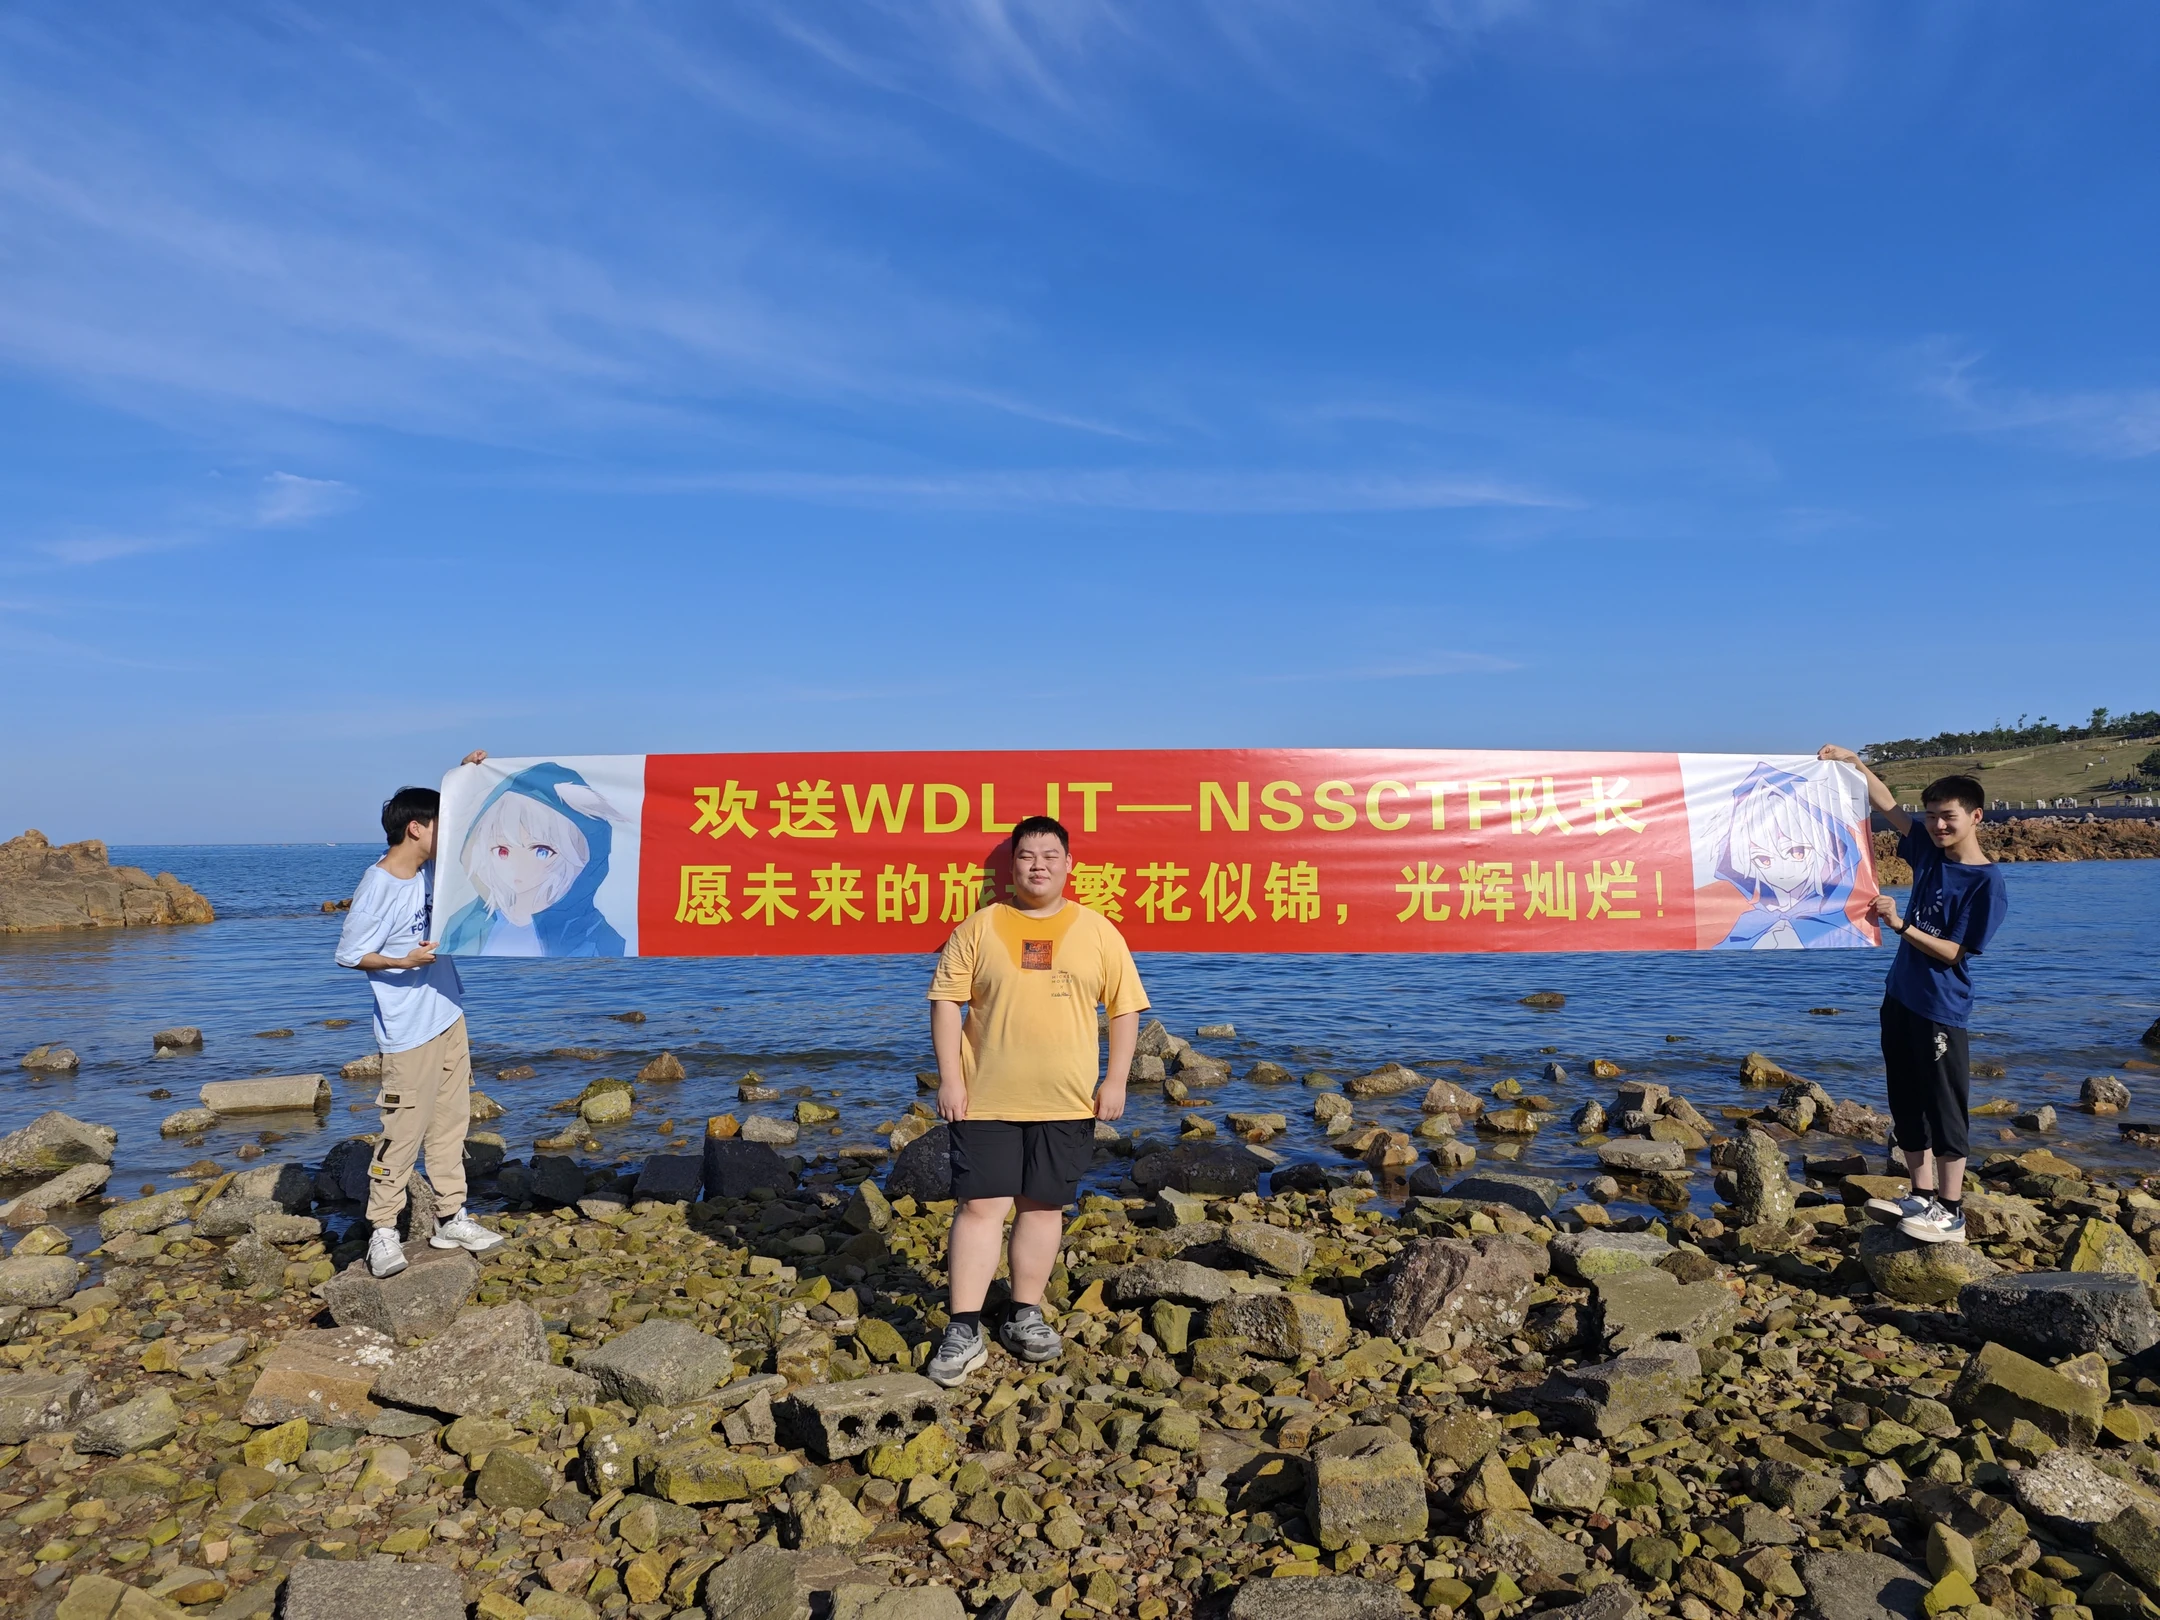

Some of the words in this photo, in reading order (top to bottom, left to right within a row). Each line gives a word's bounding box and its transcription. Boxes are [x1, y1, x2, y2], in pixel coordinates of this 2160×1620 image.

[674, 860, 1666, 925] 愿未来的旅繁花似锦，光辉灿烂！
